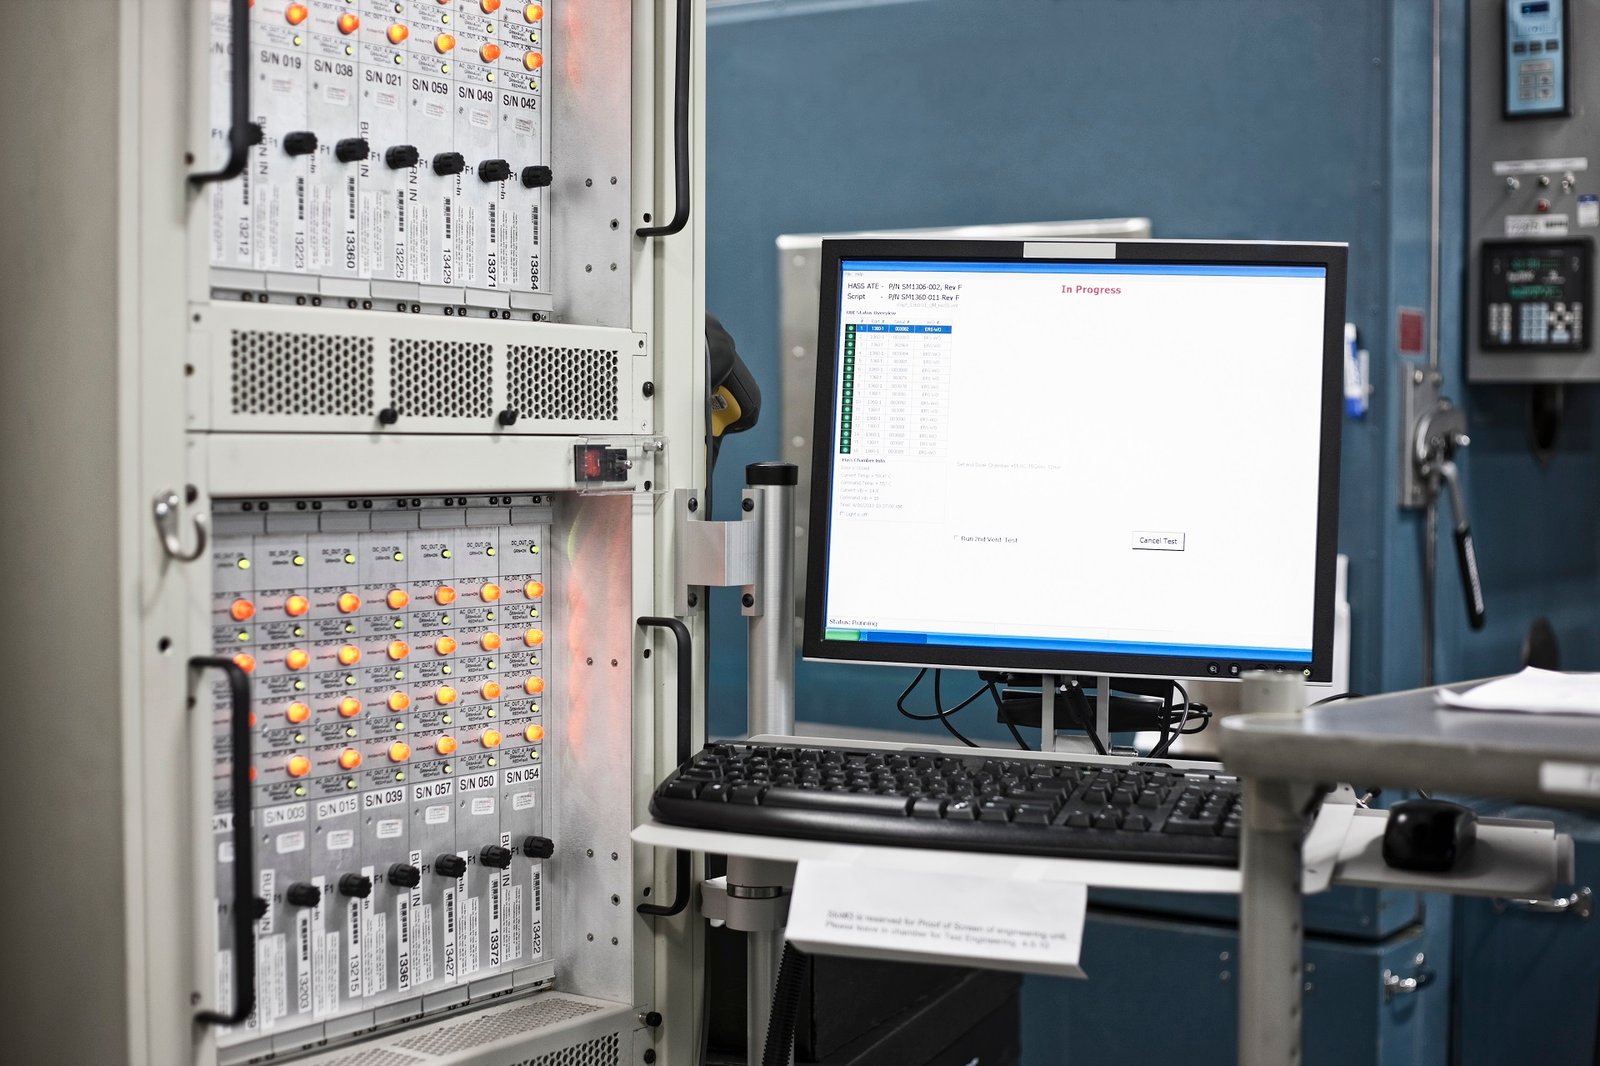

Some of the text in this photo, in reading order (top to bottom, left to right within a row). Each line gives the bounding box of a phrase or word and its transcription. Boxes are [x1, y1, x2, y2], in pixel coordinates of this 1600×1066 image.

[260, 51, 302, 69] S/N 019
[314, 60, 353, 76] S/N 038
[366, 70, 402, 87] S/N 021
[412, 79, 448, 96] S/N 059
[459, 87, 493, 102] S/N 049
[504, 94, 536, 110] S/N 042
[321, 145, 330, 154] F1
[360, 164, 368, 178] IN
[420, 159, 428, 168] F1
[465, 166, 474, 175] F1
[510, 172, 518, 181] F1
[410, 188, 417, 202] IN
[240, 216, 248, 256] 13212
[296, 232, 304, 268] 13223
[346, 230, 355, 268] 13360
[395, 242, 404, 278] 13225
[443, 248, 452, 284] 13429
[487, 252, 496, 288] 13371
[530, 254, 538, 290] 13364
[848, 293, 866, 301] Script
[1062, 285, 1122, 296] In Progress
[1139, 536, 1178, 545] Cancel Test
[852, 620, 878, 628] Running
[460, 775, 494, 790] S/N 050
[506, 768, 539, 784] S/N 054
[366, 790, 402, 806] S/N 039
[416, 782, 452, 799] S/N 057
[266, 806, 305, 824] S/N 003
[320, 799, 356, 817] S/N 015
[468, 855, 476, 865] F1
[422, 864, 430, 874] F1
[374, 874, 383, 884] F1
[502, 874, 510, 887] IN
[324, 884, 333, 894] F1
[412, 894, 420, 907] IN
[532, 920, 541, 954] 13422
[490, 928, 499, 965] 13372
[445, 942, 454, 976] 13427
[350, 954, 360, 992] 13215
[400, 953, 408, 988] 13361
[299, 971, 309, 1010] 13203
